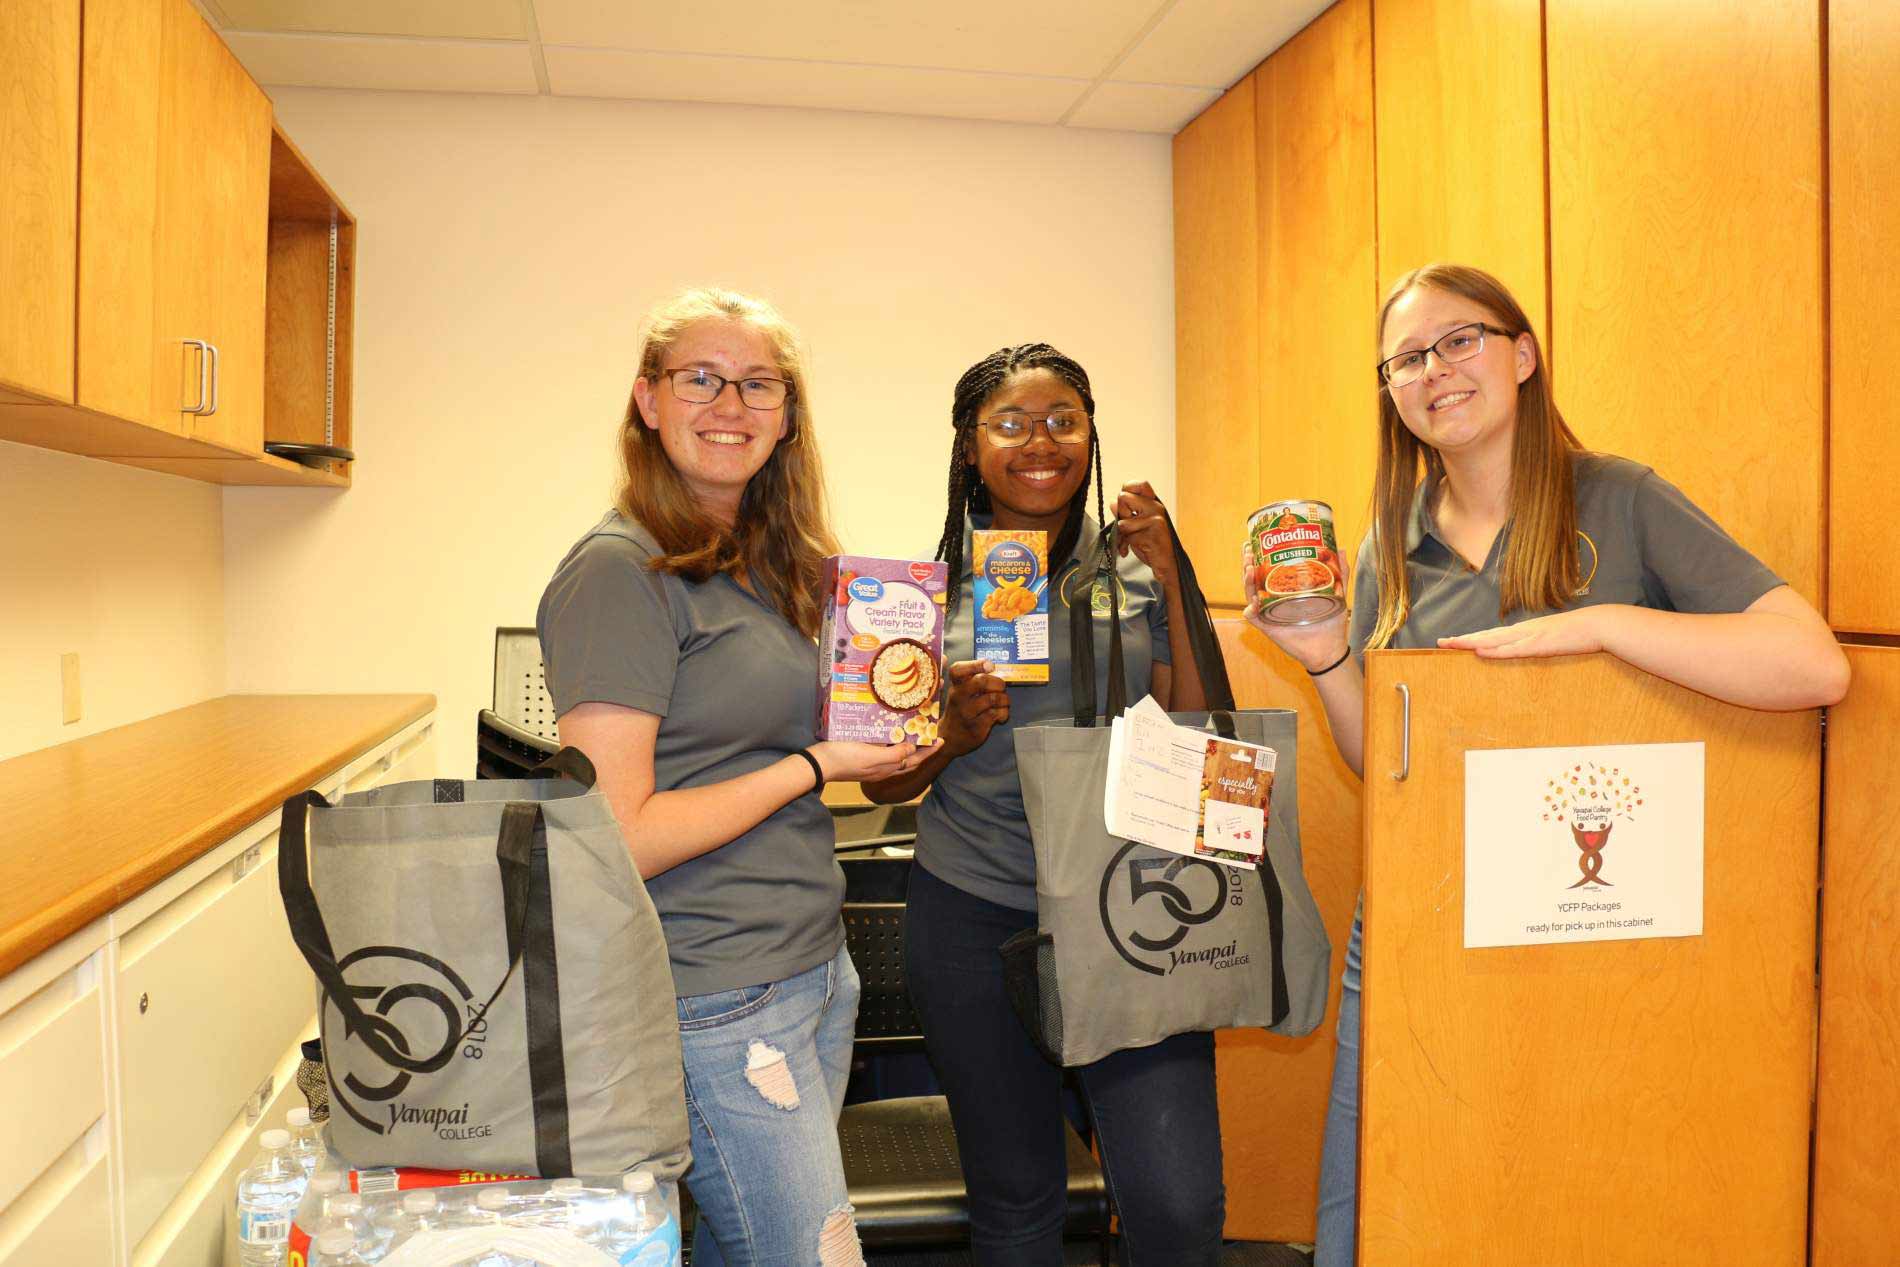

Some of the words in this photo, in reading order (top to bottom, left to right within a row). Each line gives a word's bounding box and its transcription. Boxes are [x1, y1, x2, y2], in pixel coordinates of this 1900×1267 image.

[1262, 528, 1321, 550] Contadina
[1273, 549, 1313, 562] CRUSHED
[853, 582, 878, 592] Great
[899, 600, 917, 609] Fruit
[919, 602, 926, 610] &
[865, 606, 897, 617] Cream
[899, 609, 926, 619] Flavor
[869, 617, 901, 628] Variety
[903, 619, 924, 629] Pack
[975, 635, 1014, 644] cheesiest
[1217, 775, 1258, 796] especially
[1593, 805, 1612, 814] College
[1576, 813, 1589, 821] Food
[1590, 813, 1608, 822] Pantry
[1227, 864, 1244, 907] 2018
[1557, 902, 1580, 912] YCFP
[1581, 901, 1621, 913] Packages
[1526, 922, 1549, 934] ready
[1551, 921, 1565, 931] for
[1565, 921, 1584, 933] pick
[1585, 922, 1596, 931] up
[1597, 920, 1605, 929] in
[1606, 919, 1621, 928] this
[1623, 917, 1653, 928] cabinet
[1167, 940, 1237, 975] Yavapai
[1214, 955, 1250, 970] COLLEGE
[463, 1002, 488, 1061] 2018
[387, 1103, 470, 1135] Yavapai
[439, 1125, 493, 1140] COLLEGE
